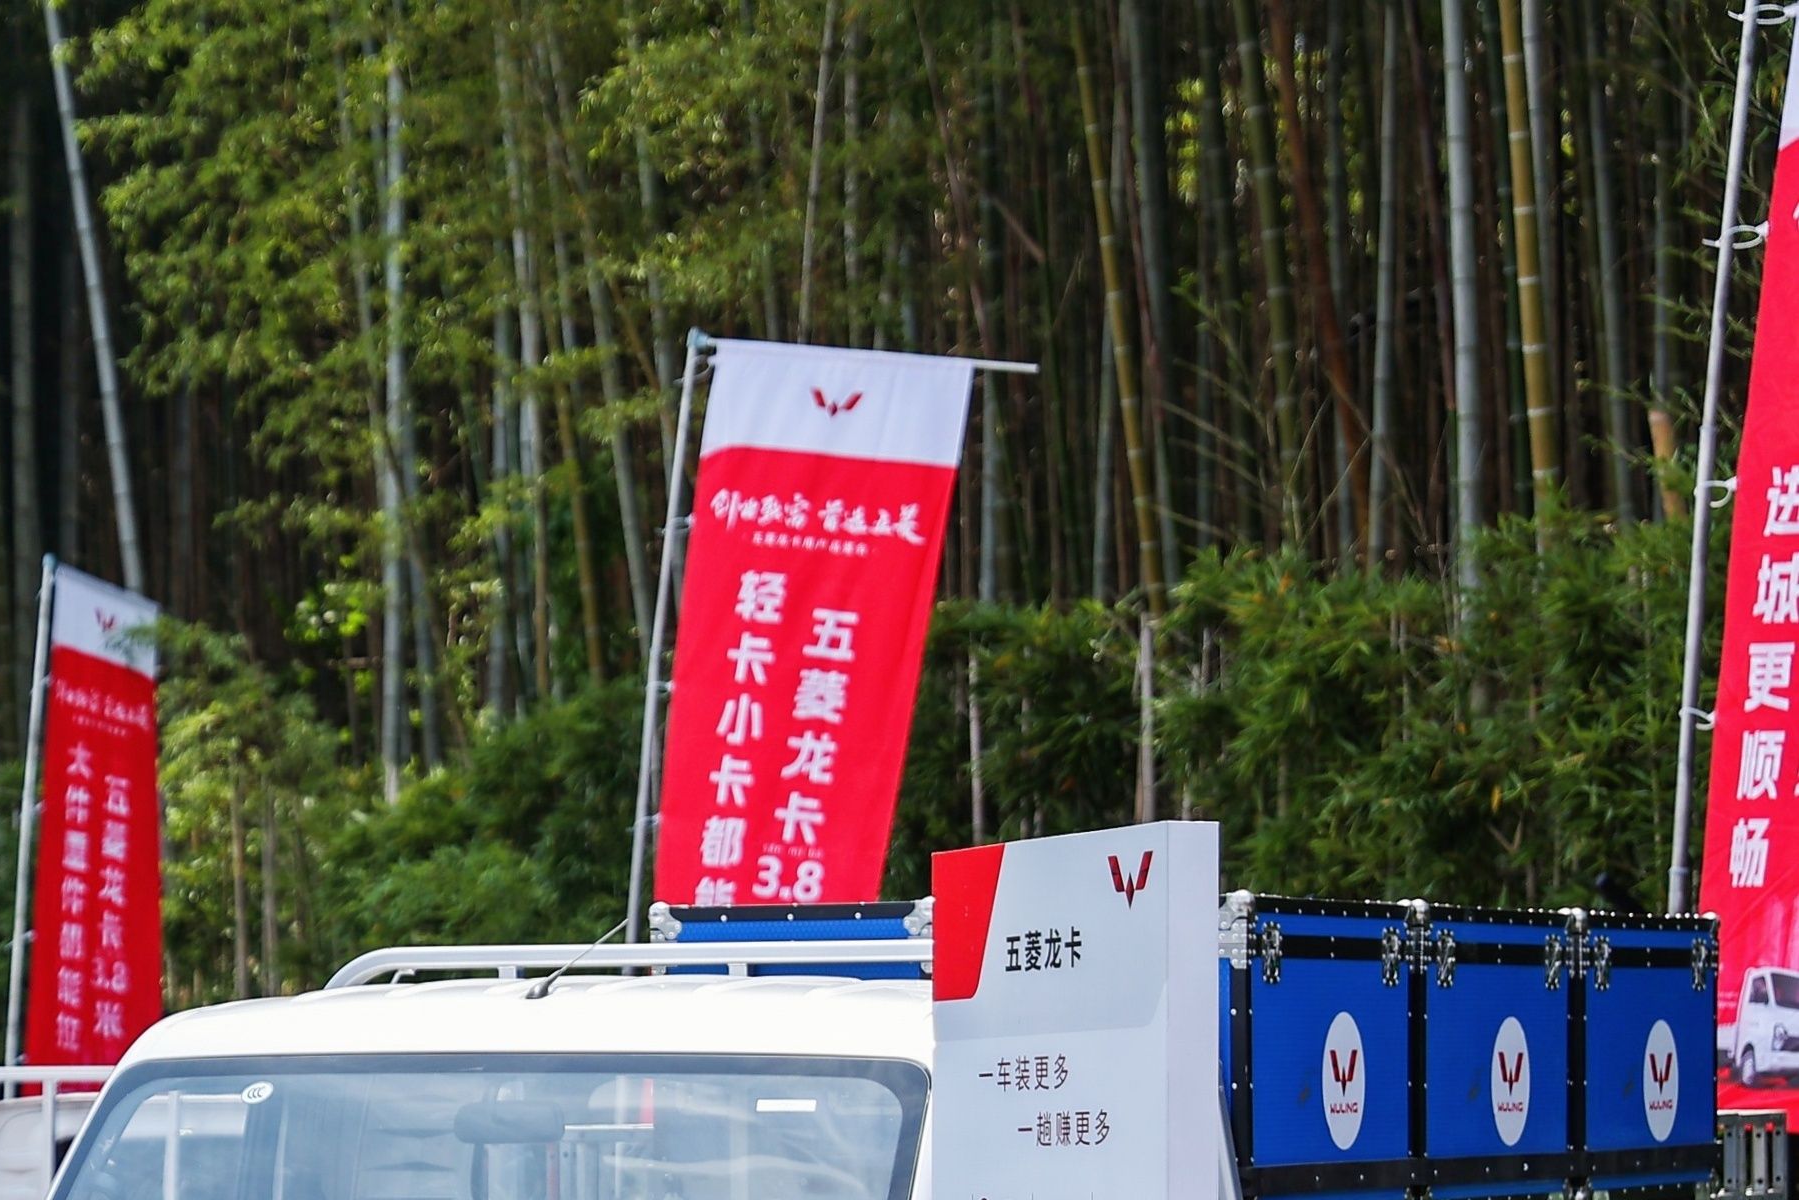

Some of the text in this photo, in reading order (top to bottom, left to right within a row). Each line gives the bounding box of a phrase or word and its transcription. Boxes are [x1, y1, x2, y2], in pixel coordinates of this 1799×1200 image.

[1004, 926, 1083, 973] 五菱龙卡
[978, 1053, 1069, 1092] 一车装更多
[1329, 1101, 1359, 1114] WULING
[1497, 1101, 1524, 1113] WULING
[1648, 1098, 1673, 1111] WULING
[1017, 1108, 1112, 1148] 一趟赚更多
